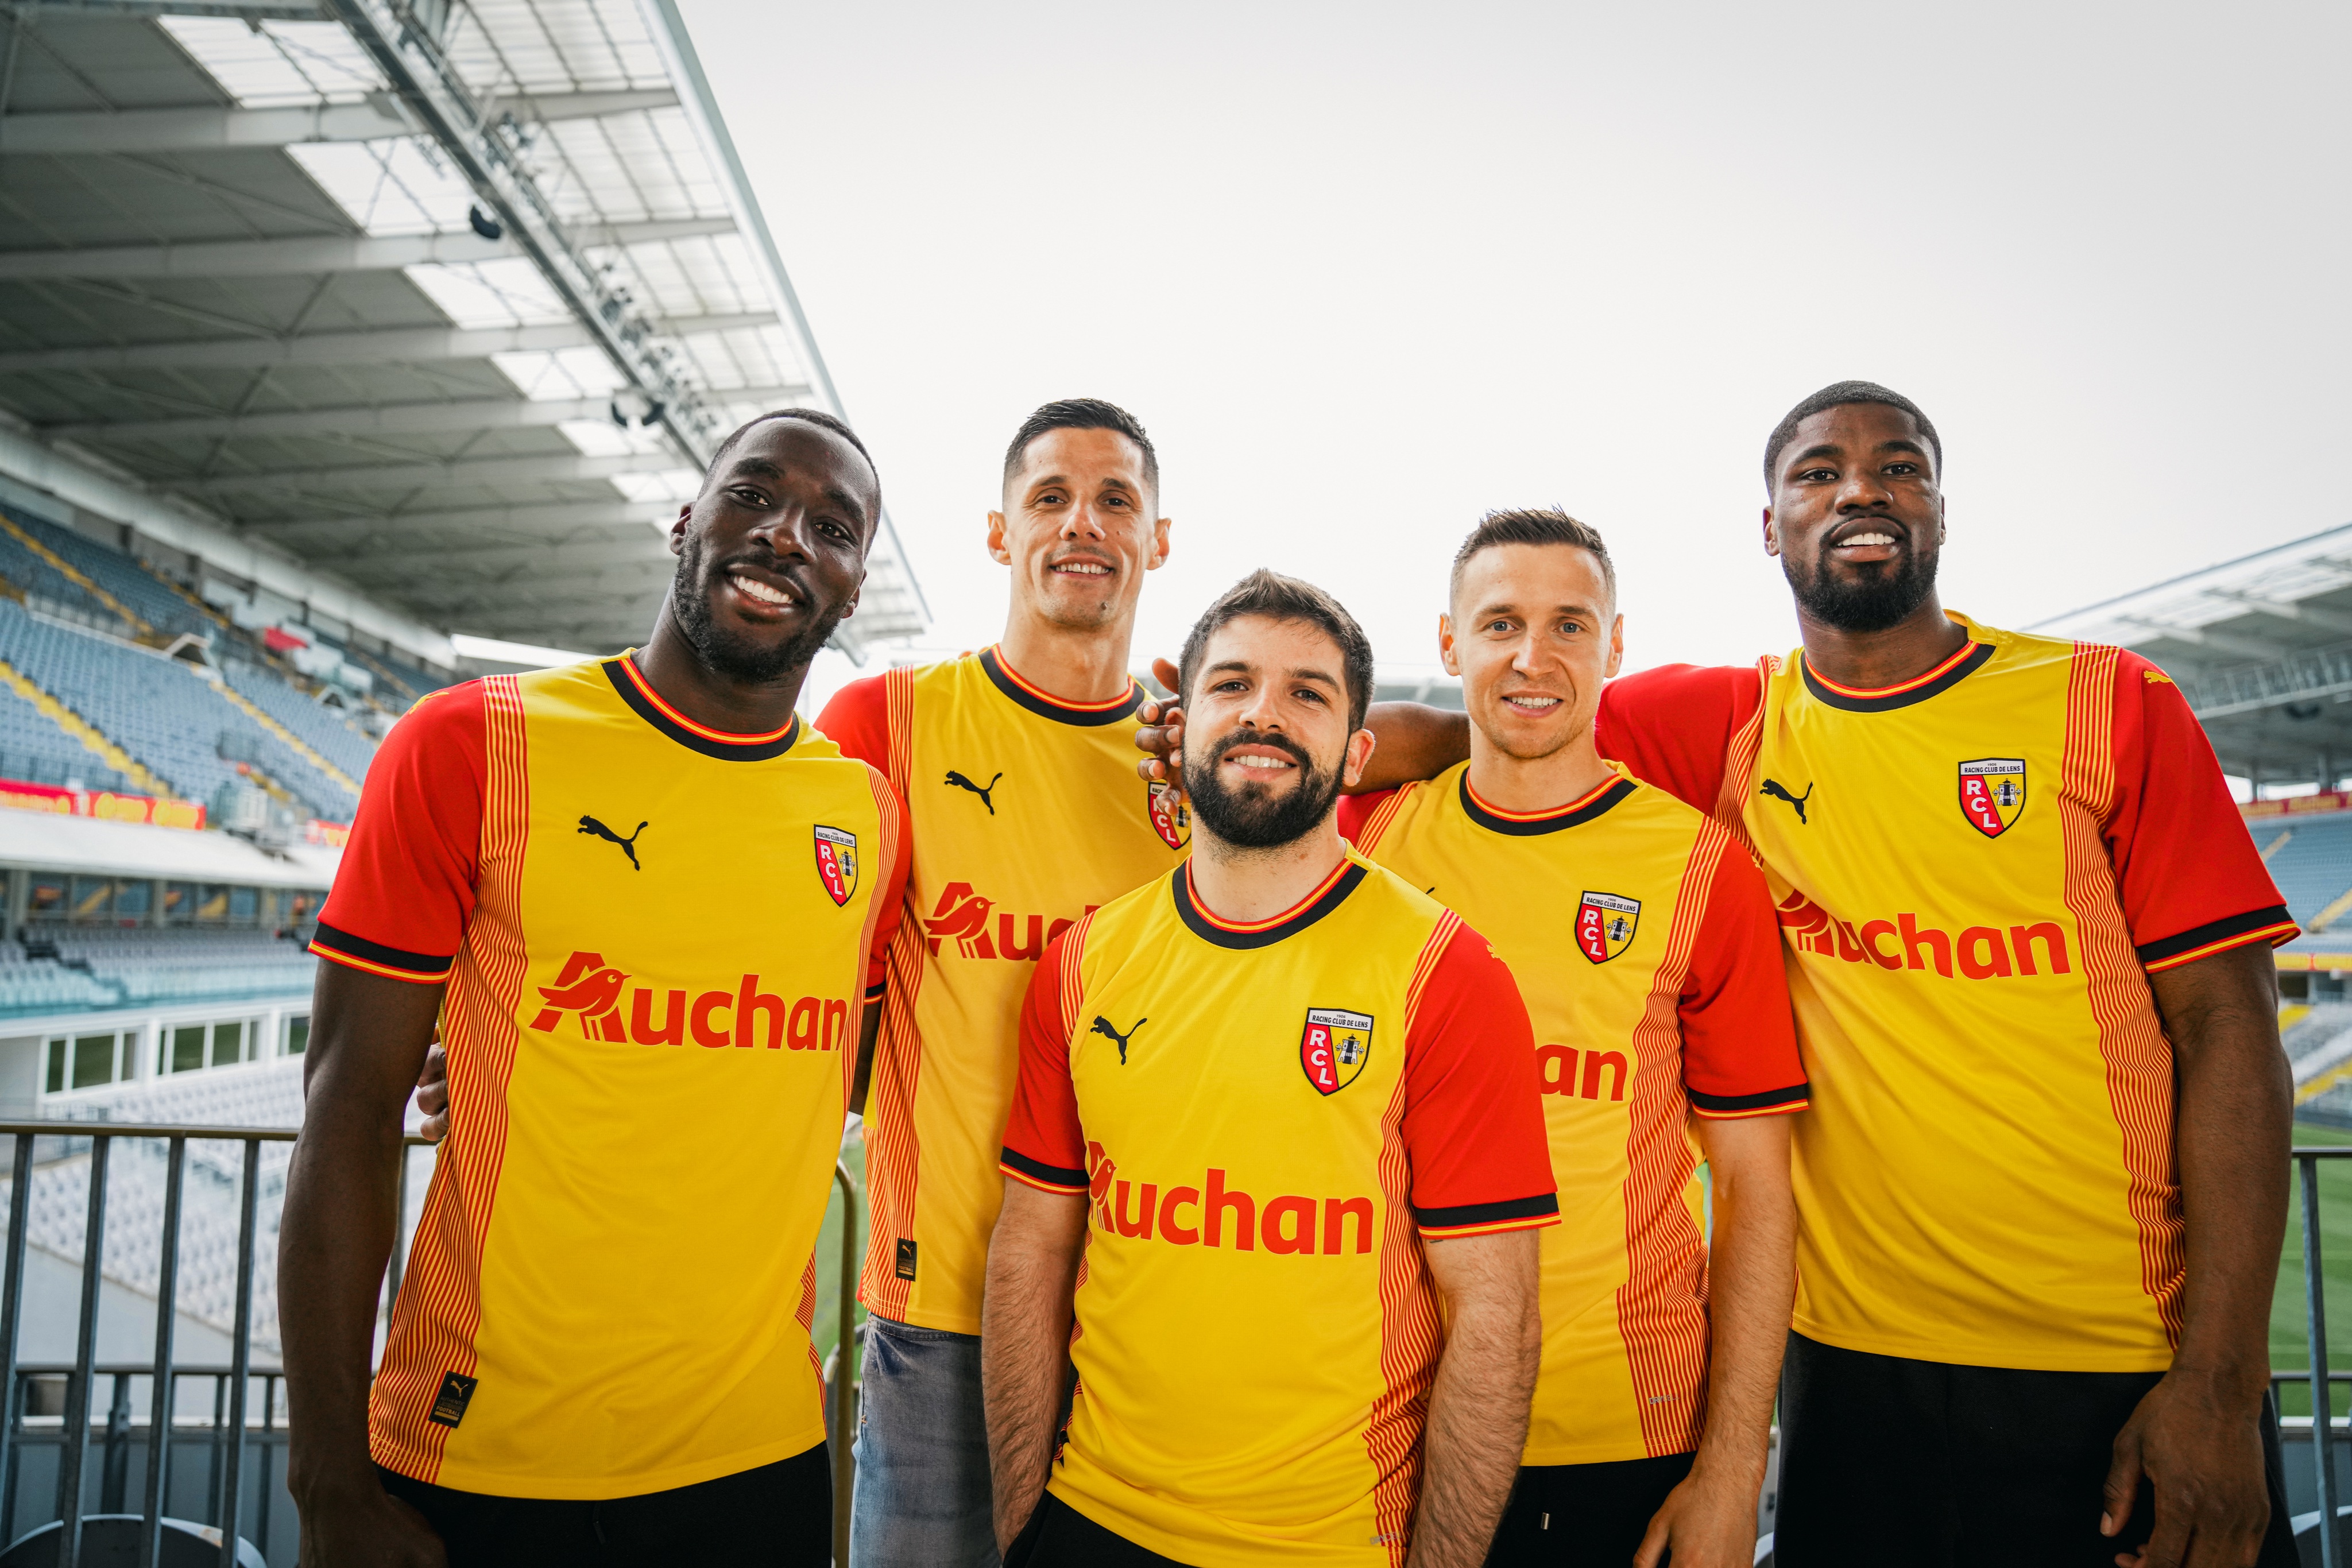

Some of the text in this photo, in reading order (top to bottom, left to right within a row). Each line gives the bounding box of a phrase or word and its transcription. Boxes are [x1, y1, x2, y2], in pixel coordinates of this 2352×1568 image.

[1967, 780, 1997, 827] RCL
[818, 831, 830, 839] RACING
[820, 844, 842, 896] RCL
[1586, 897, 1603, 905] RACING
[1583, 909, 1602, 956] RCL
[529, 951, 848, 1051] Auchan
[1312, 1015, 1332, 1023] RACING
[1309, 1029, 1332, 1085] RCL
[436, 1406, 461, 1416] FOOTBALL
